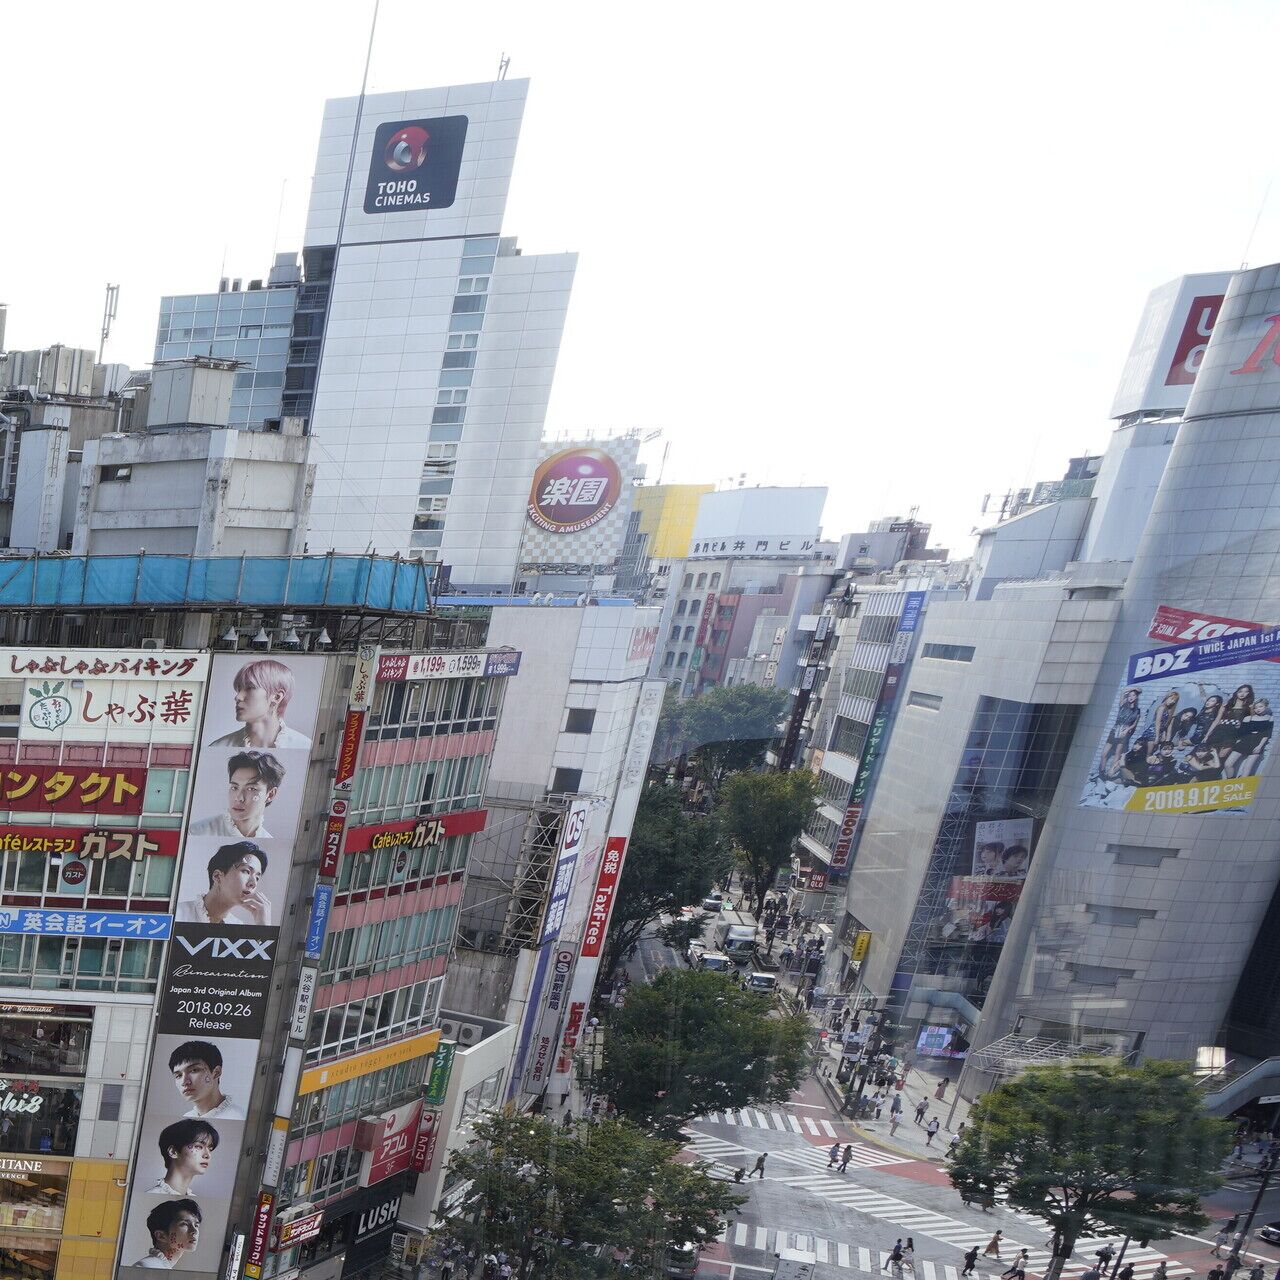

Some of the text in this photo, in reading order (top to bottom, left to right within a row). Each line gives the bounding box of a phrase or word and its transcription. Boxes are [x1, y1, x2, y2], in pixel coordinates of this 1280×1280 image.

[375, 192, 430, 206] CINEMAS
[378, 180, 417, 194] TOHO
[539, 477, 608, 506] 楽園
[527, 502, 612, 533] EXCITING AMUSEMENT
[1198, 634, 1274, 656] TWICE JAPAN 1st
[11, 654, 198, 677] しゃぶしゃぶバイキング
[1134, 647, 1195, 680] BDZ
[82, 690, 193, 725] しゃぶ葉
[341, 781, 352, 790] 8F
[1222, 792, 1252, 802] SALE
[1224, 783, 1244, 792] ON
[1144, 785, 1220, 811] 2018.9.12
[78, 832, 159, 860] ガスト
[412, 820, 446, 848] ガスト
[832, 808, 860, 865] HOOTERS
[325, 832, 340, 868] ガスト
[604, 850, 620, 874] 免税
[810, 880, 824, 888] QLO
[812, 874, 824, 882] UNI
[23, 912, 167, 935] 英会話イーオン
[586, 885, 612, 946] TaxFree
[176, 935, 275, 960] VIXX
[172, 964, 268, 979] Reincarnation
[170, 986, 262, 998] Japan 3rd Original Album
[294, 974, 312, 1034] 渋谷駅前ビル
[177, 1000, 252, 1017] 2018.09.26
[188, 1018, 232, 1030] Release
[380, 1133, 408, 1160] アコム
[415, 1136, 428, 1160] アコム
[357, 1197, 400, 1235] LUSH
[252, 1212, 268, 1261] サンドラッグ
